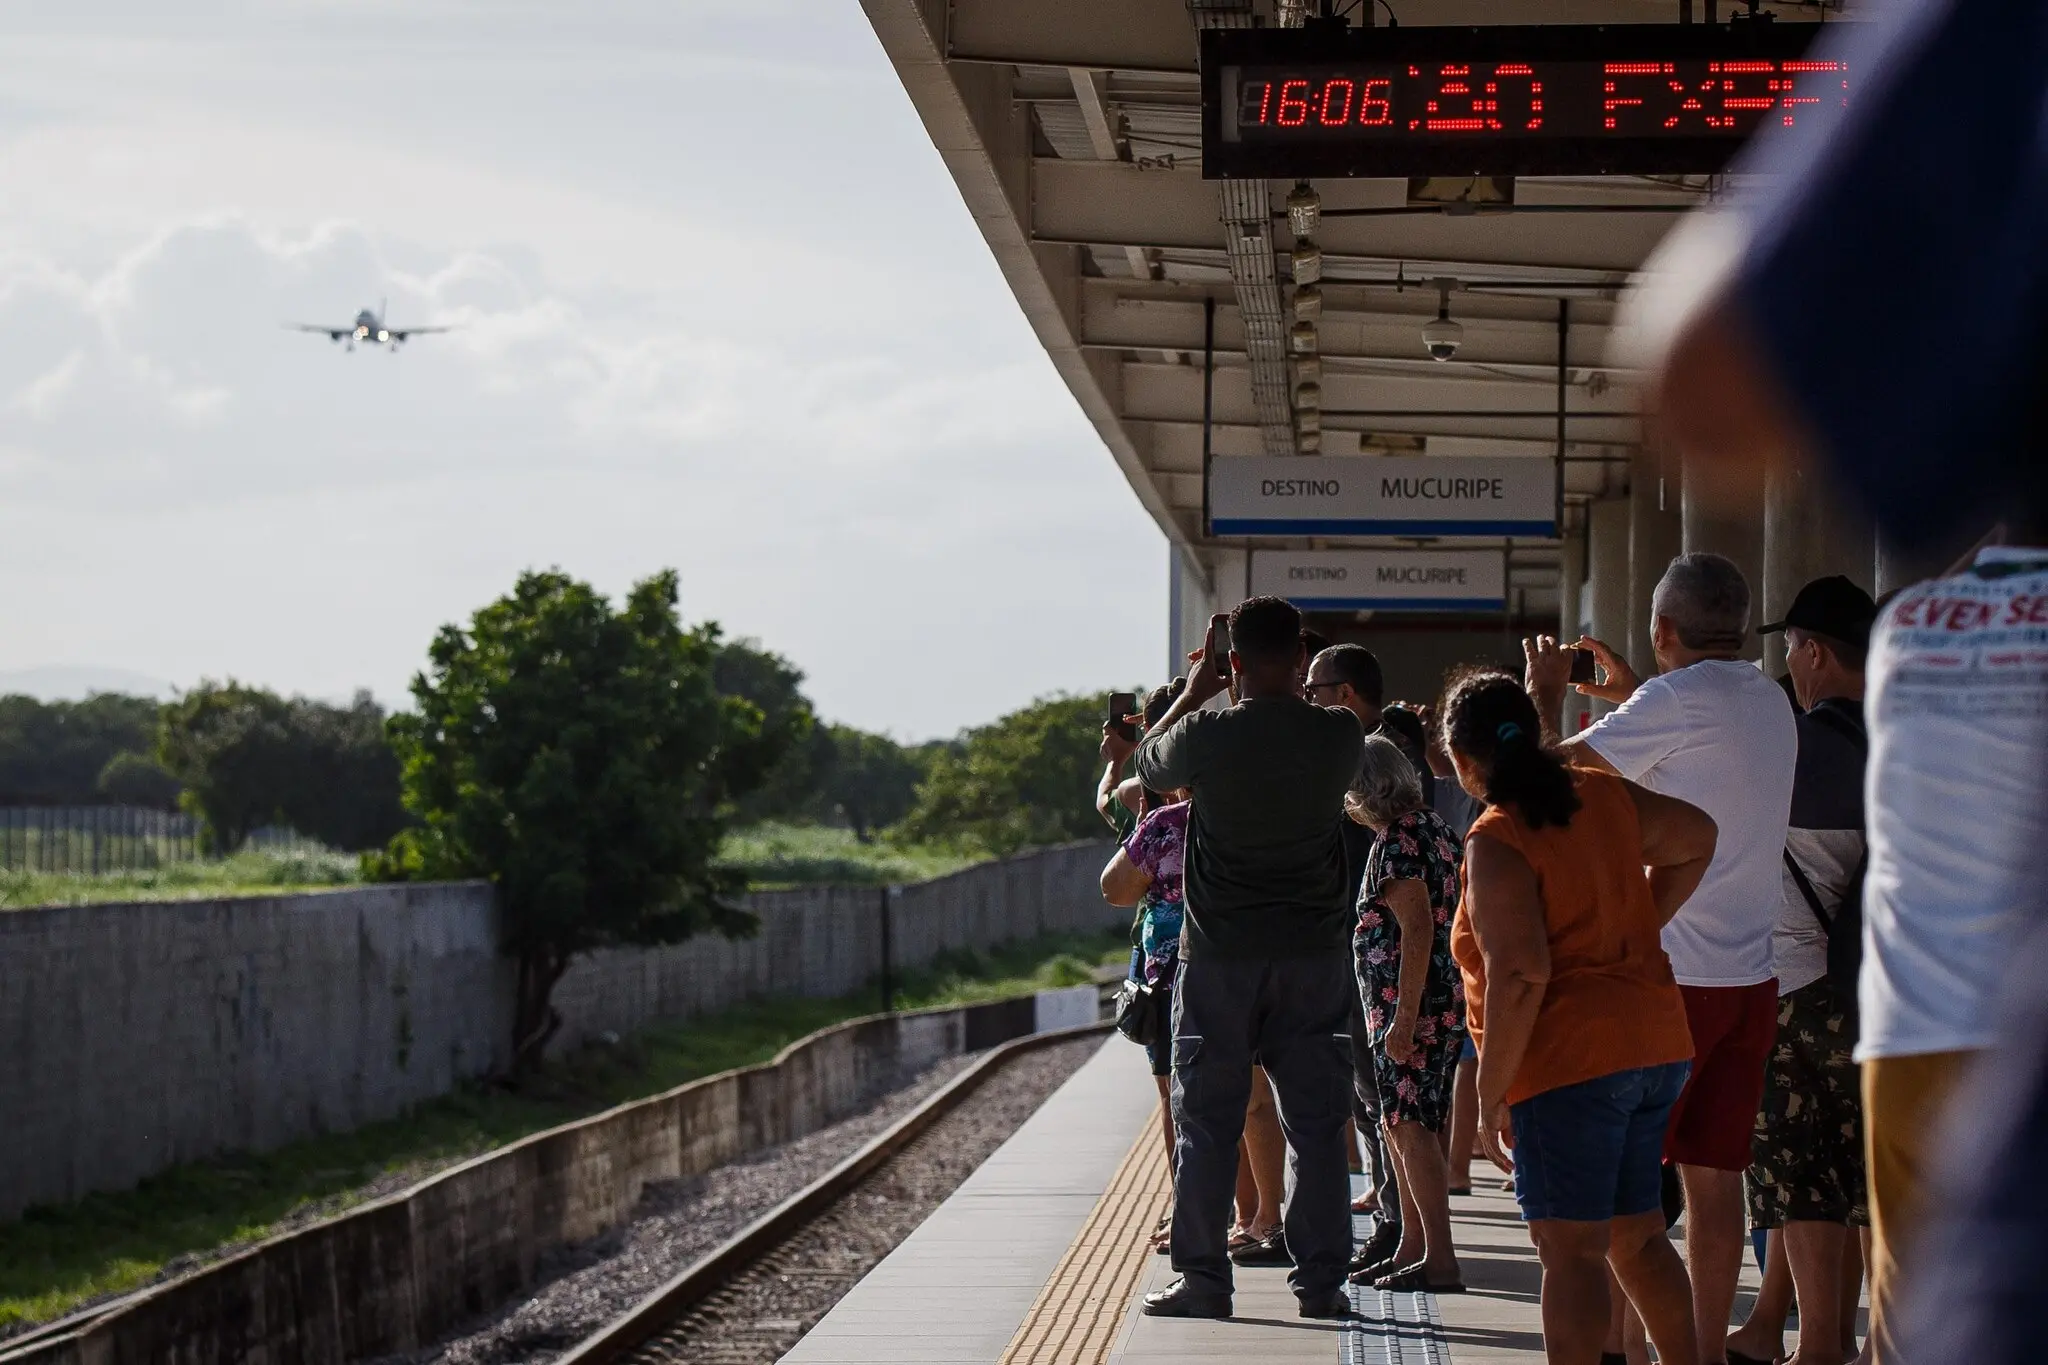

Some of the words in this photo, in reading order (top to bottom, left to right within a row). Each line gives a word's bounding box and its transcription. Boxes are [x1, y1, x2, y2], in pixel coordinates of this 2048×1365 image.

[1261, 479, 1340, 497] DESTINO
[1381, 478, 1504, 500] MUCURIPE
[1288, 567, 1347, 581] DESTINO
[1377, 567, 1467, 585] MUCURIPE
